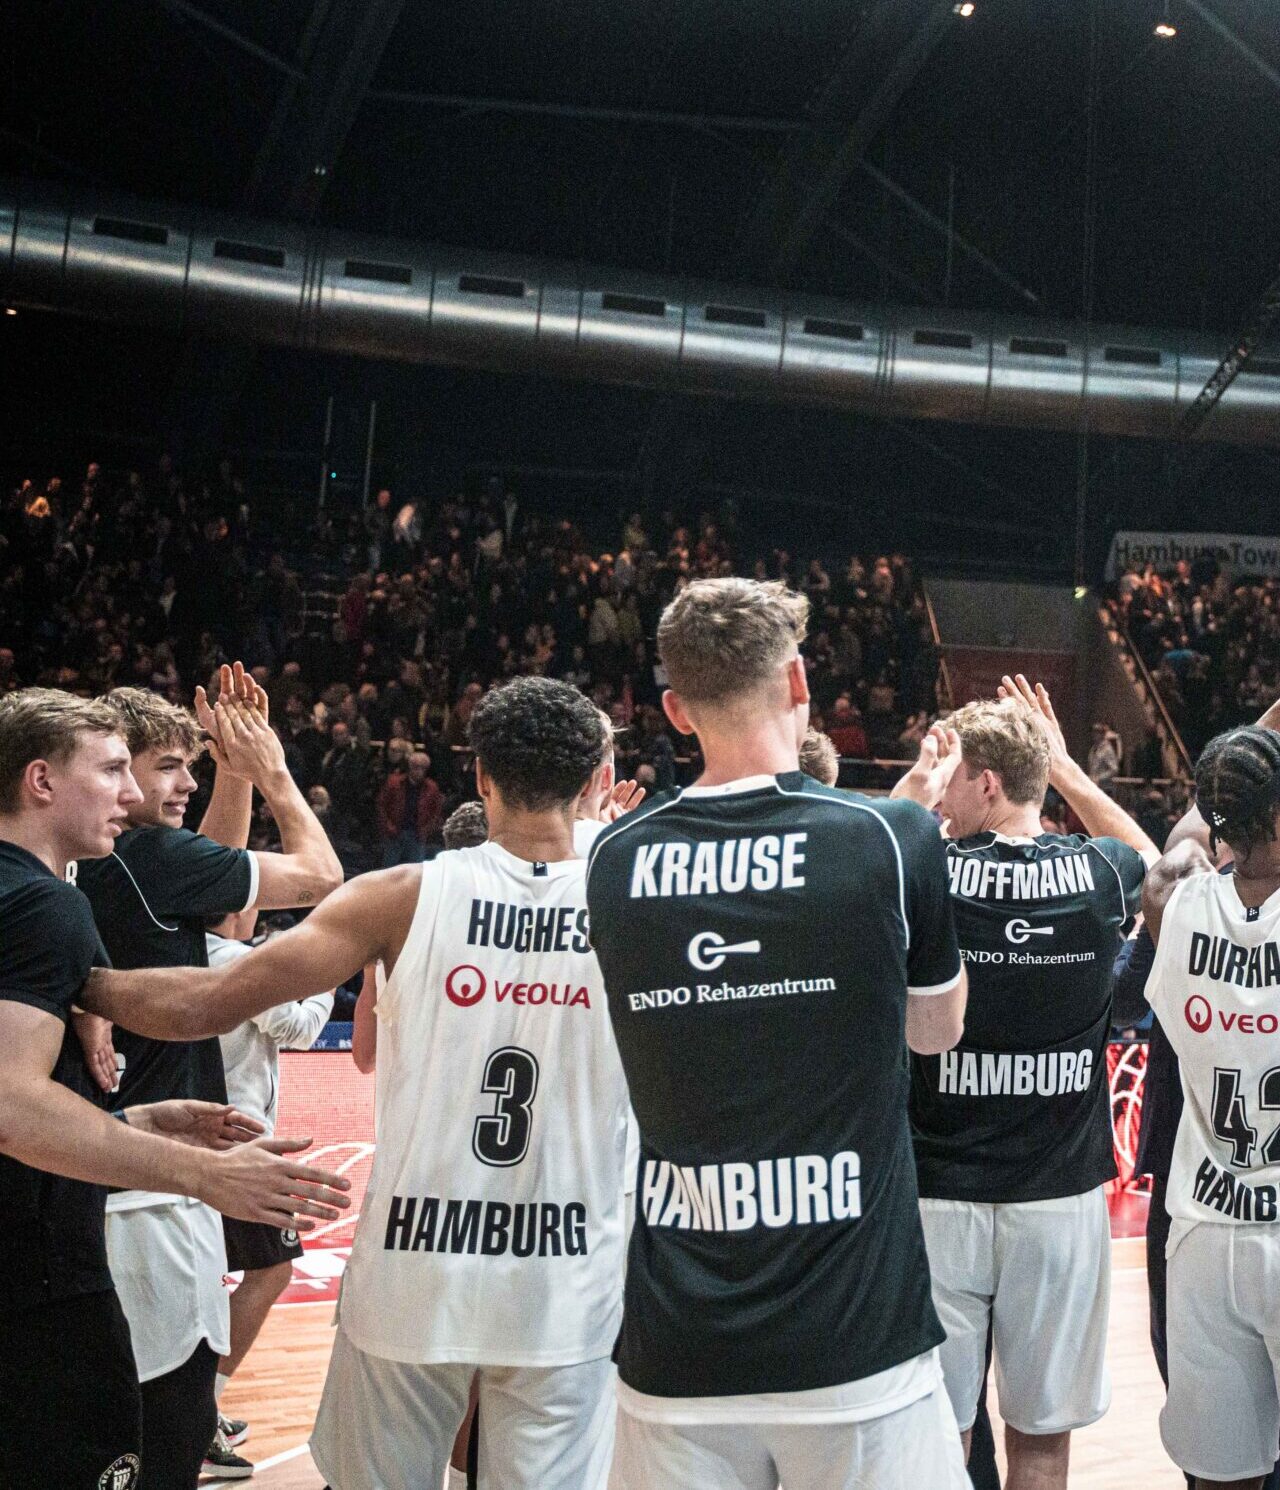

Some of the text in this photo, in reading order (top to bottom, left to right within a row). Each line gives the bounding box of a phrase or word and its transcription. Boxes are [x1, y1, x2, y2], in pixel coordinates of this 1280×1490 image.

[1115, 540, 1229, 564] Hambu
[630, 832, 808, 898] KRAUSE
[947, 854, 1095, 899] HOFFMANN
[467, 899, 592, 953] HUGHES
[959, 949, 1095, 965] ENDO Rehazentrum
[495, 980, 591, 1009] VEOLIA
[628, 977, 836, 1011] ENDO Rehazentrum
[939, 1049, 1093, 1097] HAMBURG
[472, 1046, 540, 1168] 3
[643, 1150, 862, 1232] HAMBURG
[384, 1196, 588, 1258] HAMBURG
